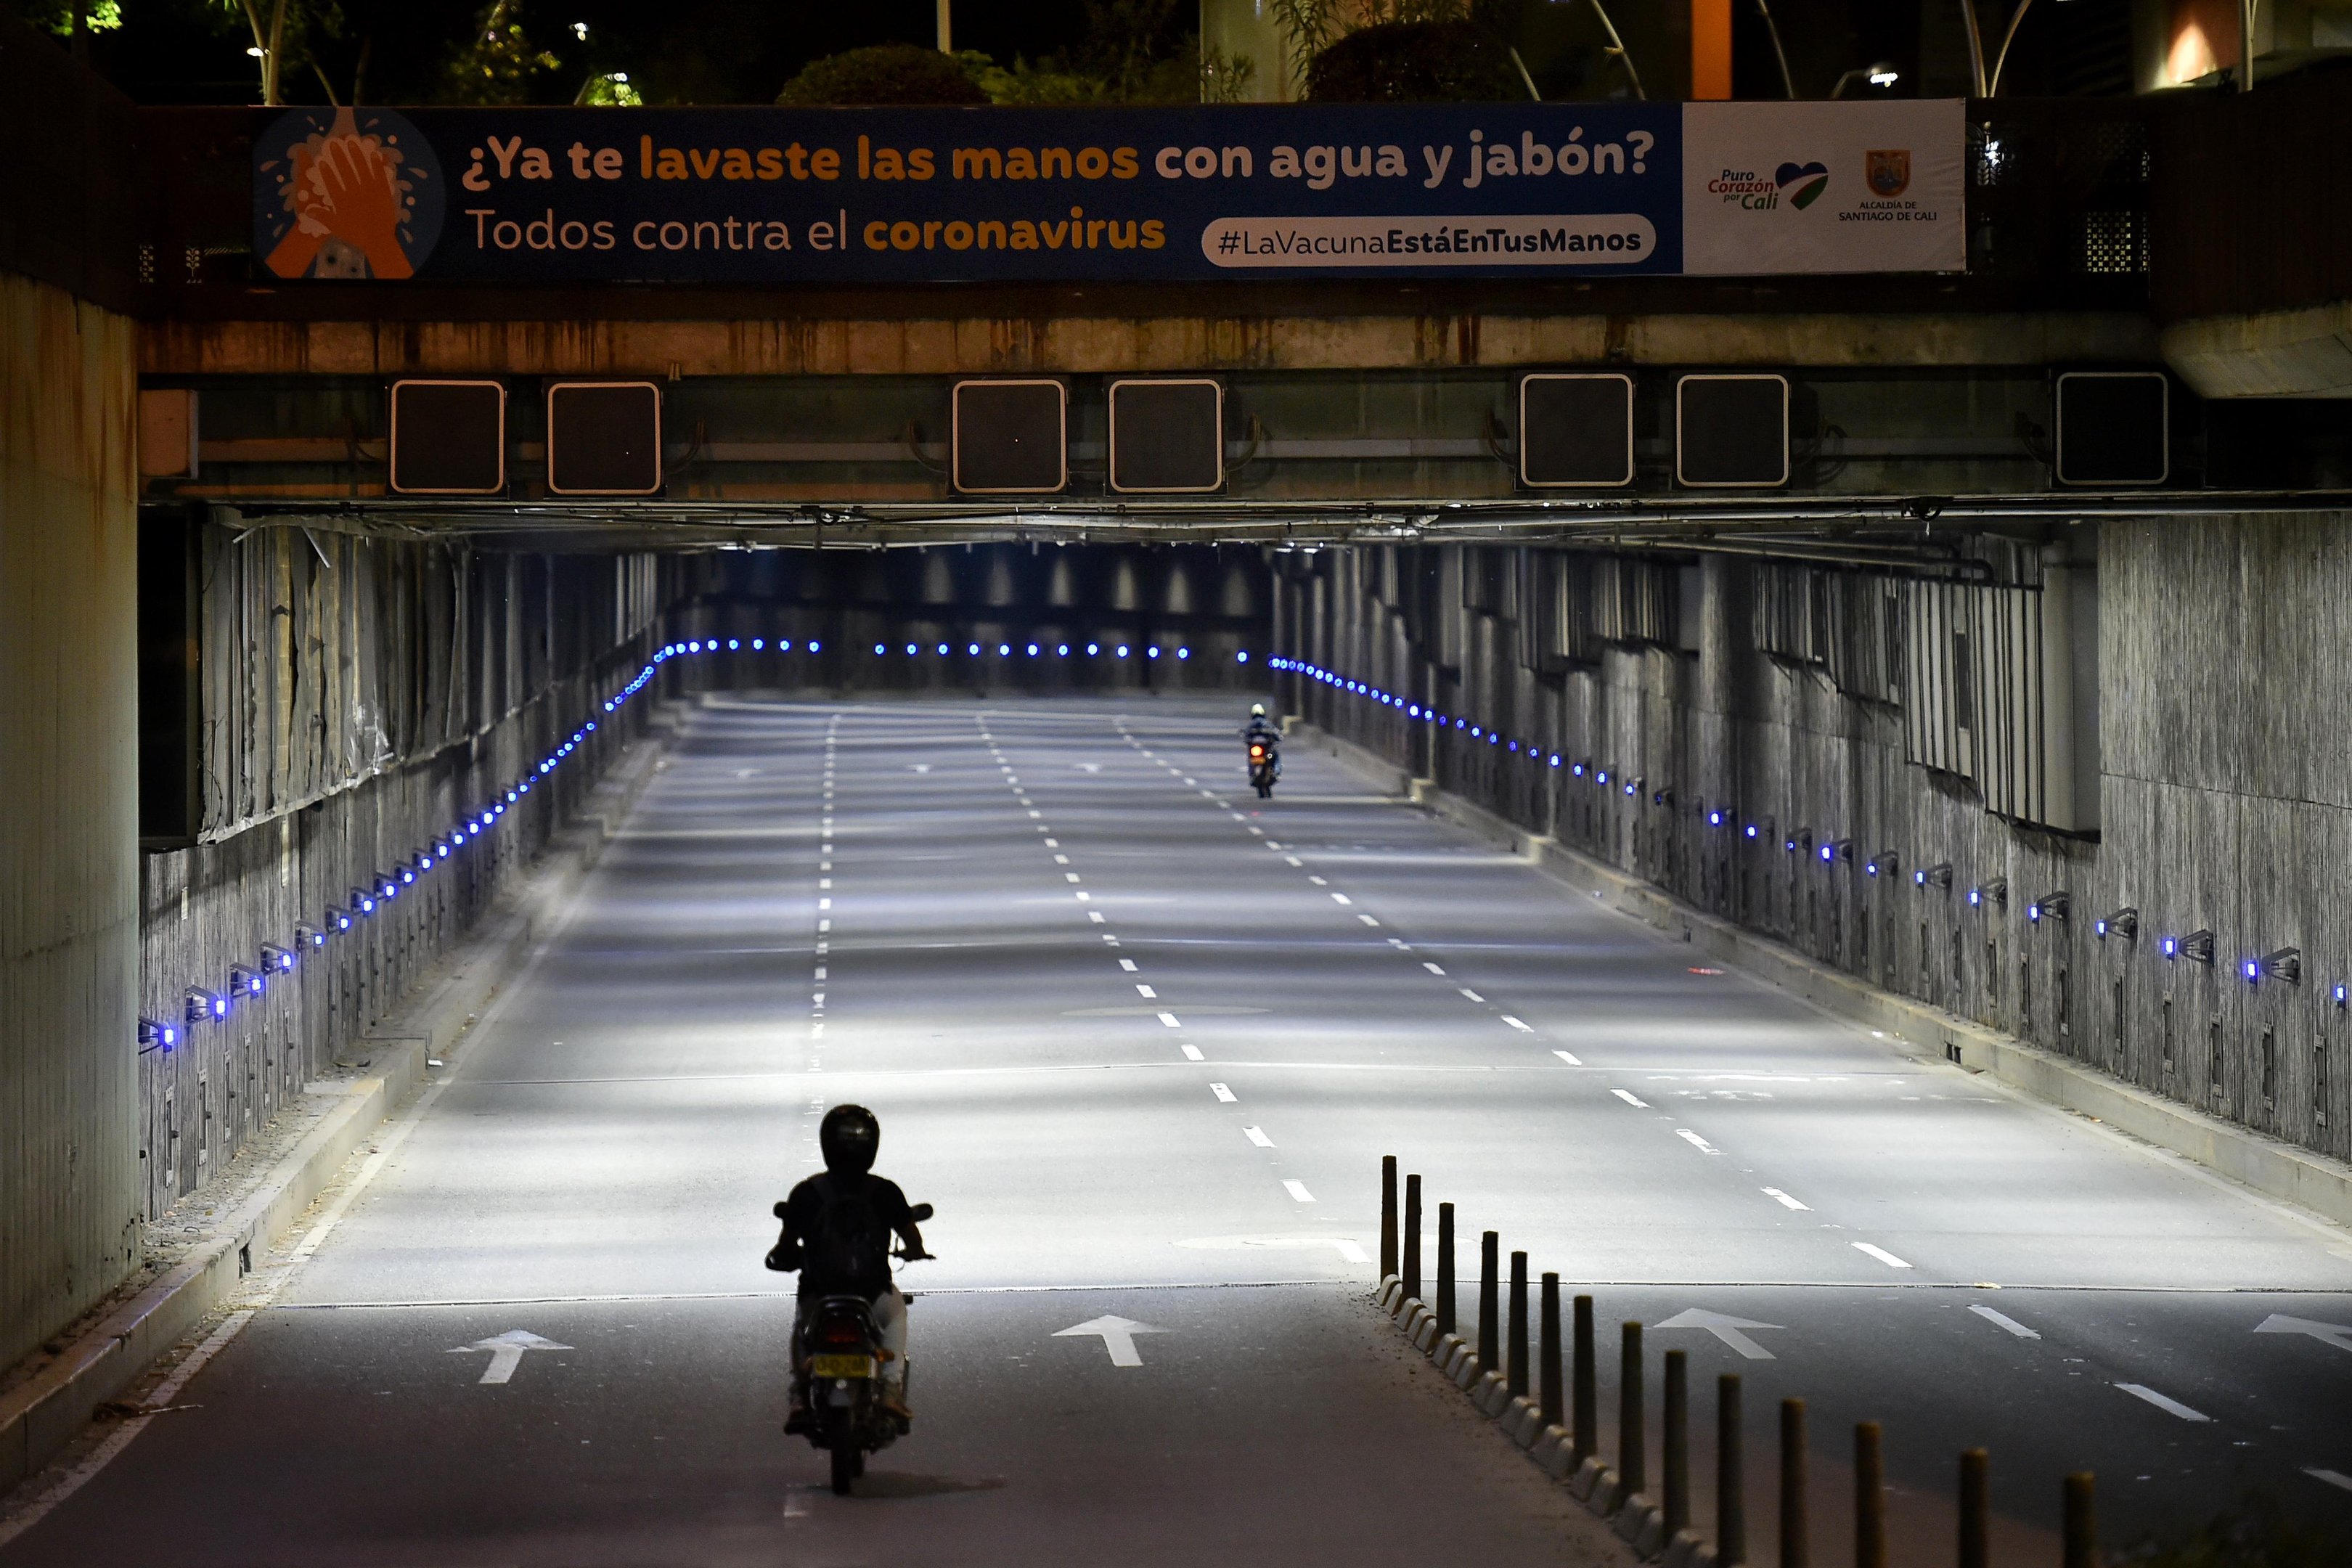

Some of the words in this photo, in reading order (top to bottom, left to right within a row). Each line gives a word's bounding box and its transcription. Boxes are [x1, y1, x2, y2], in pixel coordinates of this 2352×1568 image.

[463, 136, 552, 192] ¿Ya
[568, 142, 623, 180] te
[641, 135, 840, 180] lavaste
[858, 135, 935, 180] las
[952, 147, 1139, 180] manos
[1155, 146, 1253, 179] con
[1270, 145, 1408, 190] agua
[1423, 145, 1453, 189] y
[1462, 126, 1654, 189] jabón?
[1721, 169, 1755, 181] Puro
[1707, 179, 1774, 193] Corazón
[1723, 193, 1739, 203] por
[1741, 192, 1778, 210] Cali
[1859, 200, 1903, 209] ALCALDÍA
[1839, 211, 1893, 221] SANTIAGO
[1897, 212, 1911, 221] DE
[1914, 211, 1937, 221] CALI
[465, 208, 616, 250] Todos
[633, 216, 791, 251] contra
[808, 208, 846, 250] el
[864, 206, 1165, 251] coronavirus
[1218, 226, 1641, 255] #LaVacunaEstáEnTusManos
